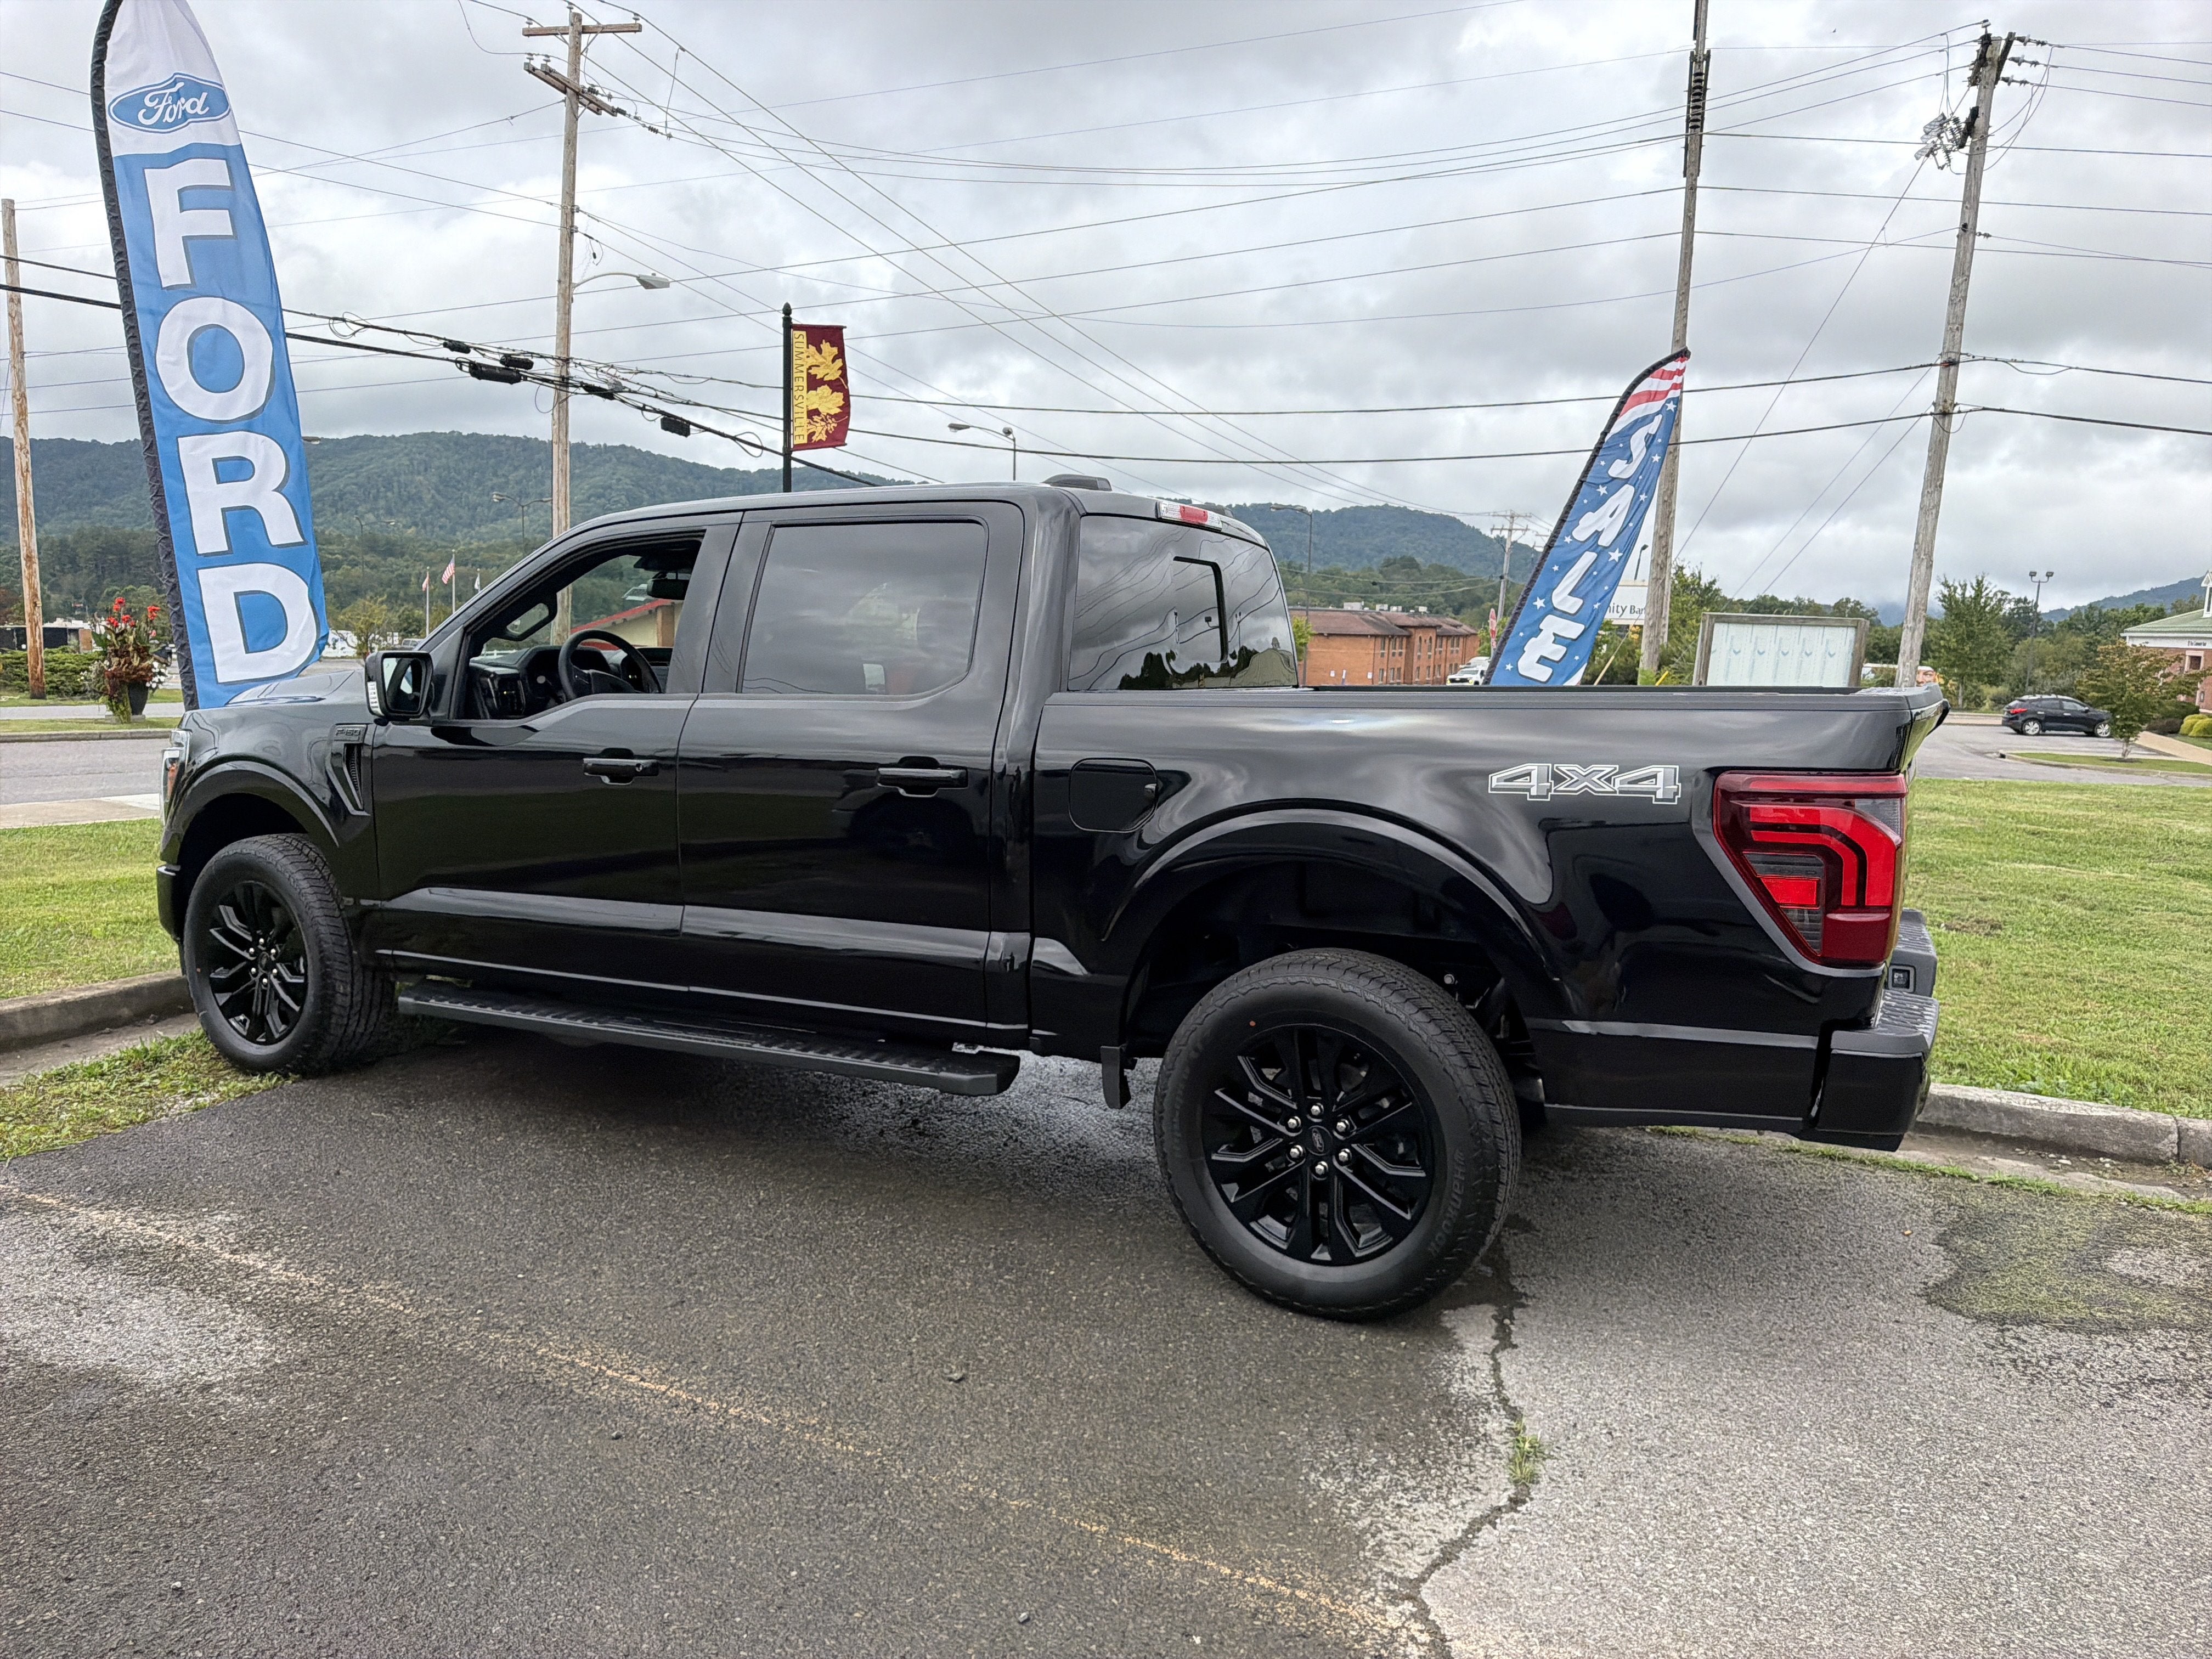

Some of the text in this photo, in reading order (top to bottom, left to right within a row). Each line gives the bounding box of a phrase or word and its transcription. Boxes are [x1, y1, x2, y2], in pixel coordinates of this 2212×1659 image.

[138, 82, 210, 126] Ford
[144, 158, 318, 684] FORD
[794, 332, 805, 441] SUMMERSVILLE
[1517, 414, 1663, 684] SALE
[1609, 602, 1646, 618] nity Ban
